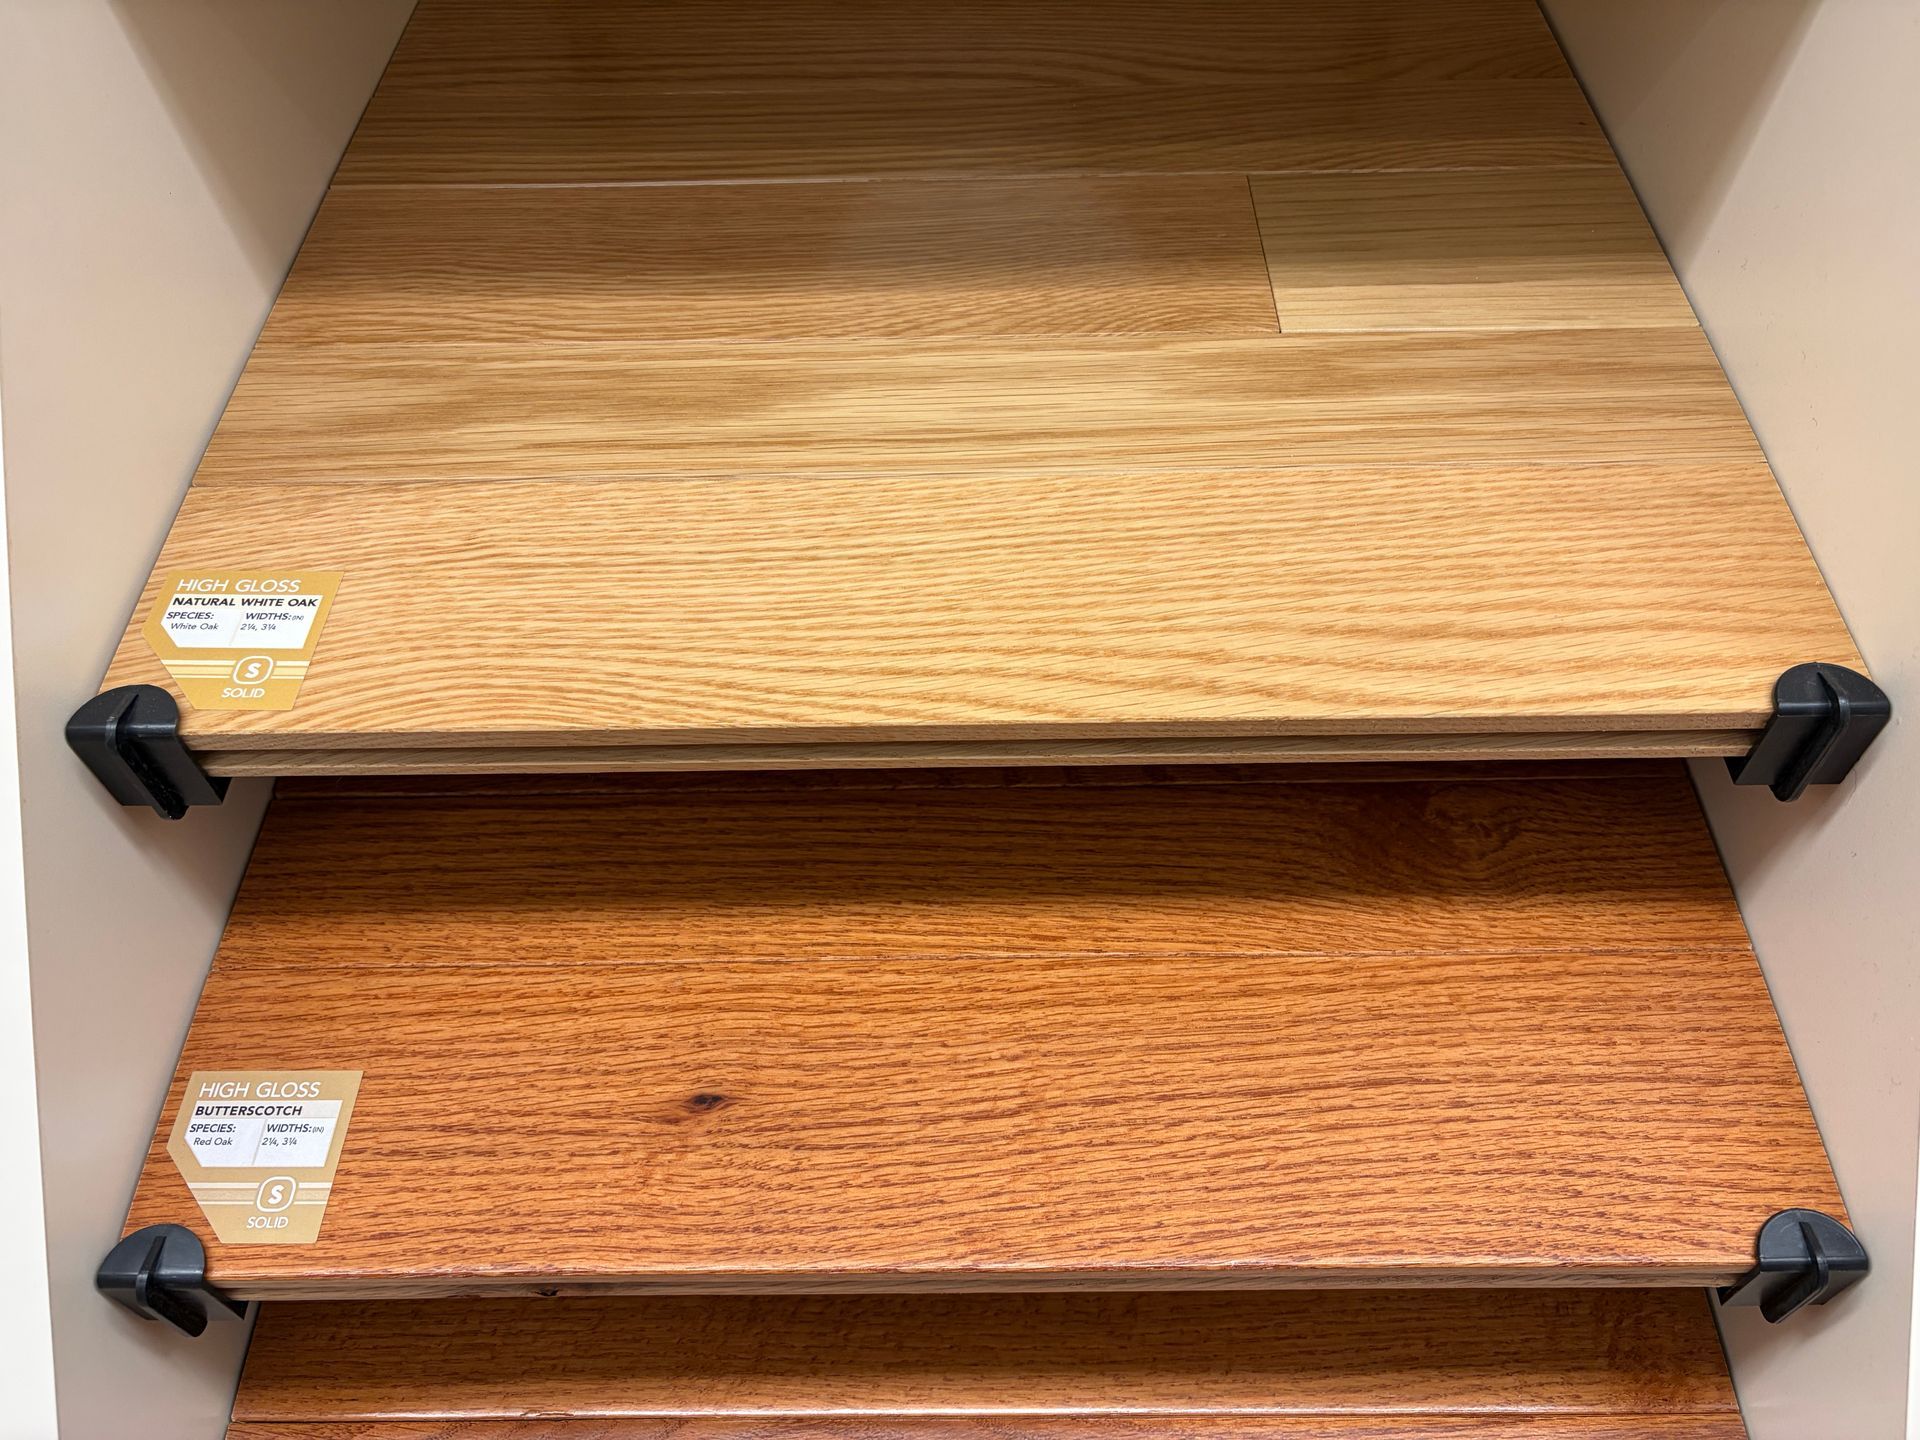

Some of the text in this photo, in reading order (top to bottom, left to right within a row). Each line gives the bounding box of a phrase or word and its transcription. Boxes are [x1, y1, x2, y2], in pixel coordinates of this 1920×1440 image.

[176, 578, 302, 593] HIGH GLOSS
[172, 597, 319, 607] NATURAL WHITE OAK
[166, 611, 215, 620] SPECIES:
[170, 622, 197, 630] White
[244, 662, 262, 679] S
[221, 687, 266, 698] SOLID
[199, 1081, 321, 1099] HIGH GLOSS
[195, 1105, 303, 1116] BUTTERSCOTCH
[189, 1123, 237, 1133] SPECIES:
[193, 1137, 233, 1146] Red Oak
[268, 1184, 285, 1204] S
[246, 1216, 289, 1229] SOLID
